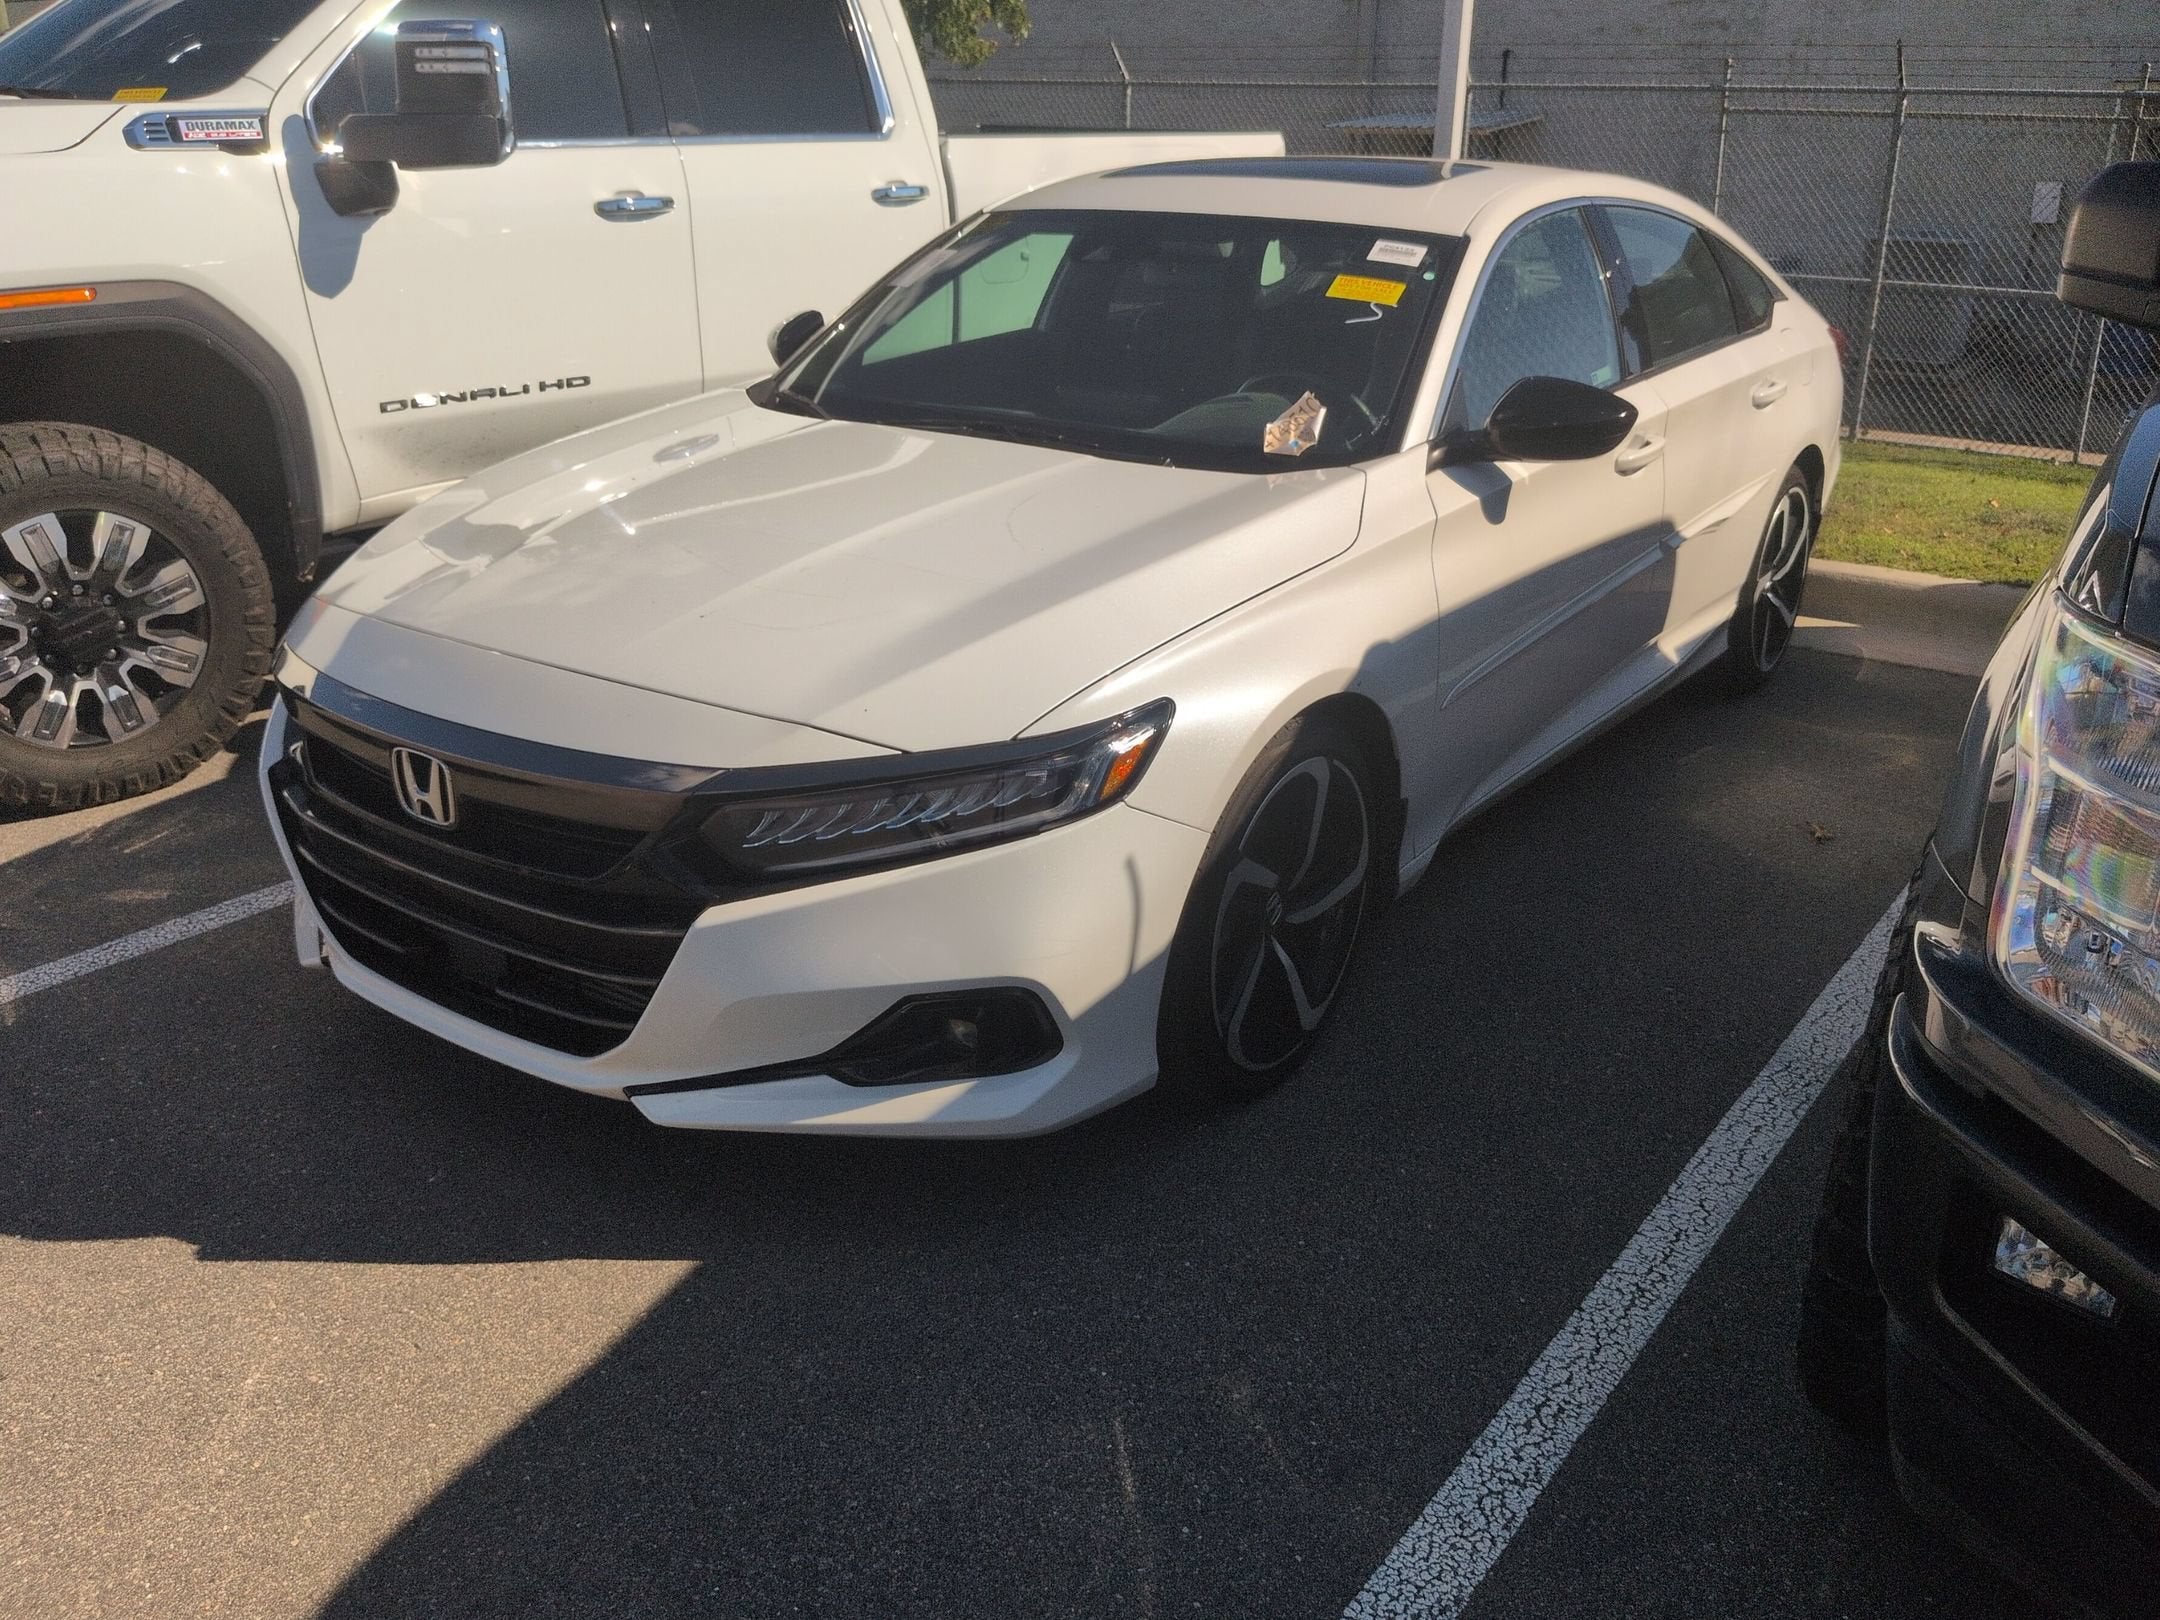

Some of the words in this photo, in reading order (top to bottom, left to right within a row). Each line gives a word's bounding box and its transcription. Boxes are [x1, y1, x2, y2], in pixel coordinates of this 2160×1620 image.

[185, 121, 255, 131] DURAMAX
[380, 383, 530, 413] DENALI
[539, 376, 591, 392] HD
